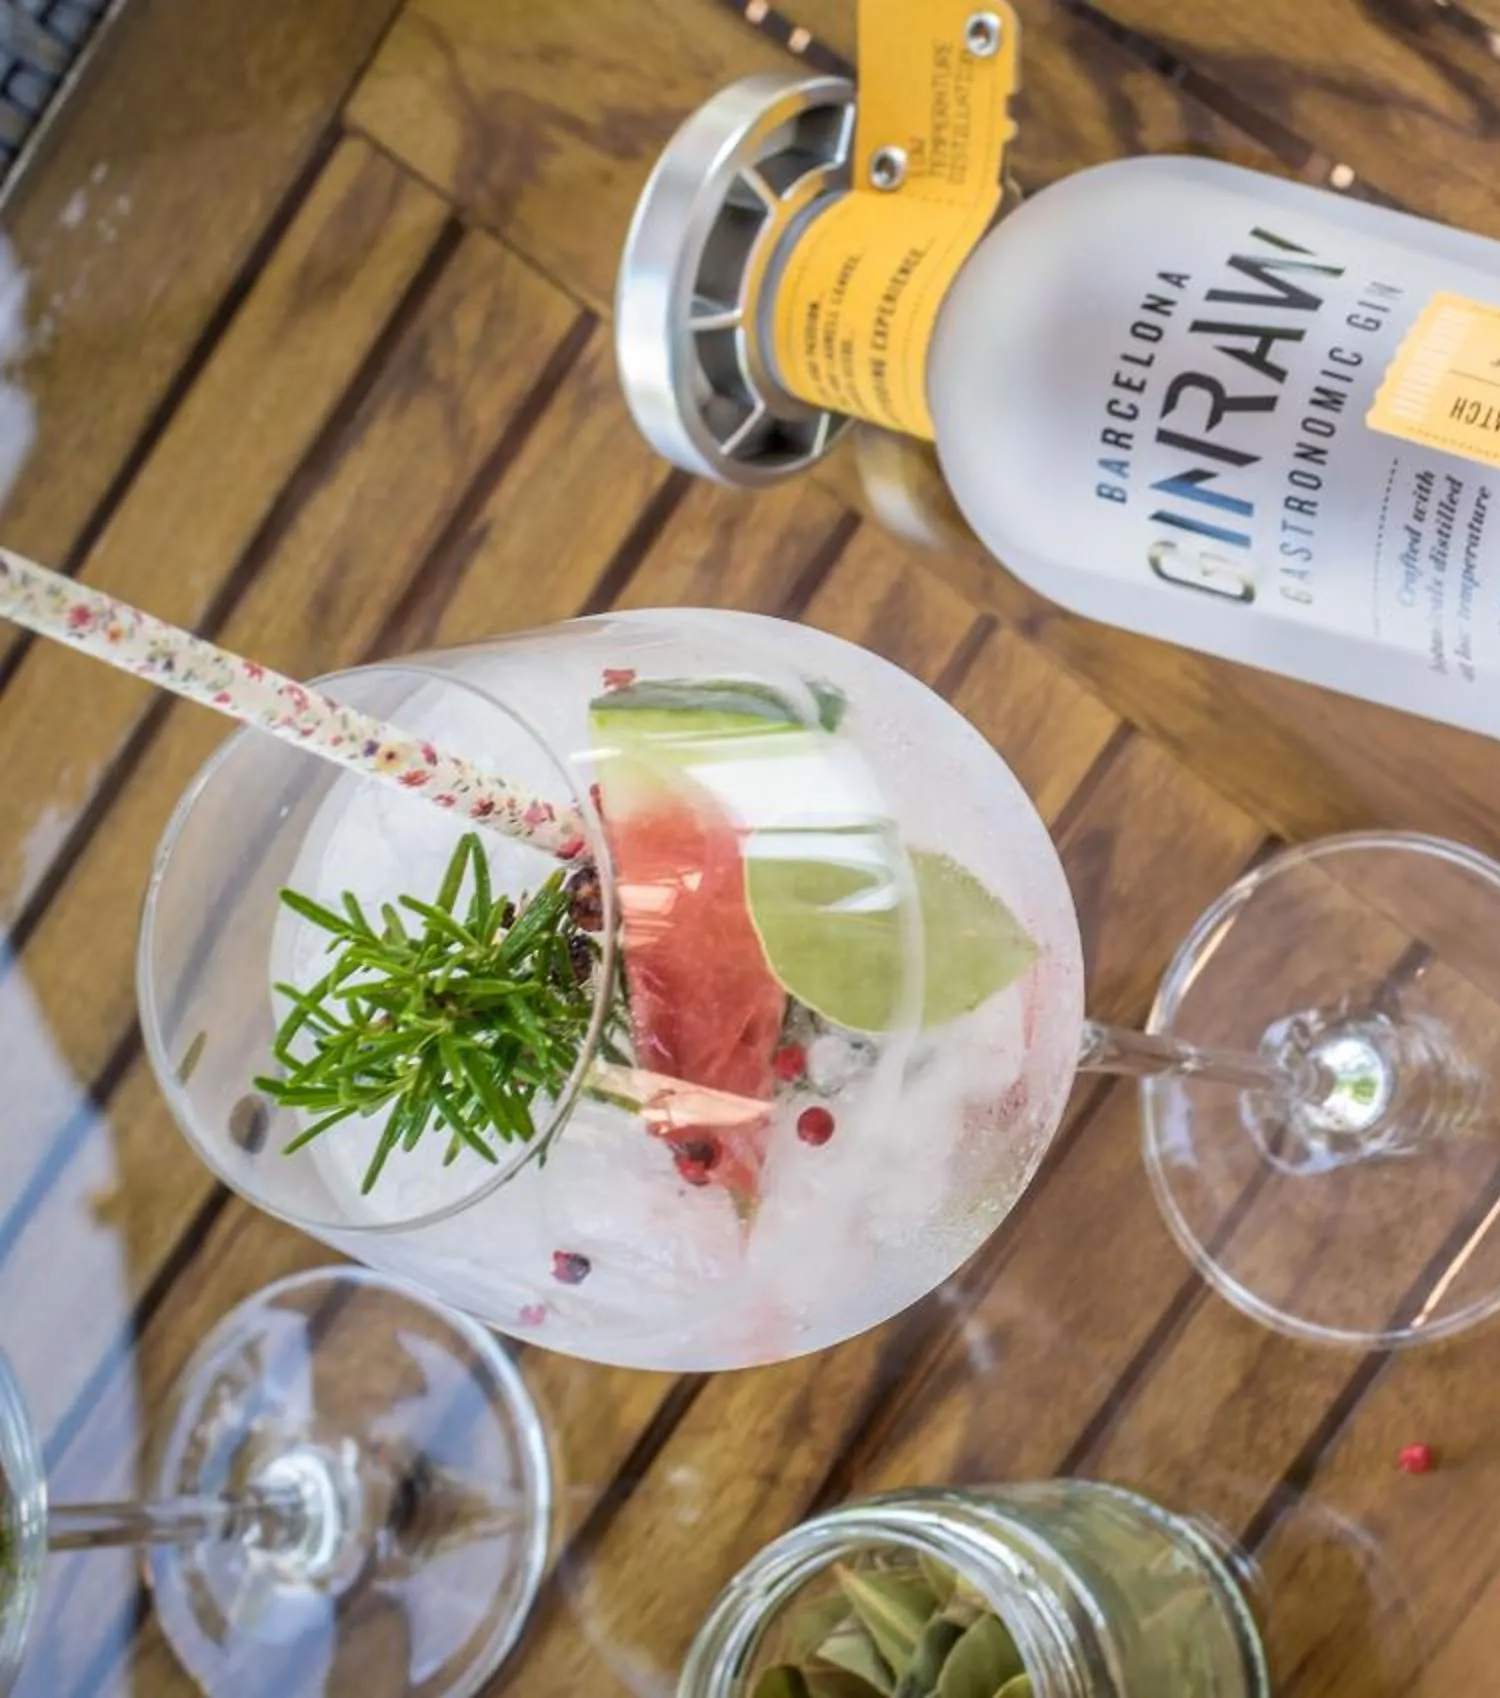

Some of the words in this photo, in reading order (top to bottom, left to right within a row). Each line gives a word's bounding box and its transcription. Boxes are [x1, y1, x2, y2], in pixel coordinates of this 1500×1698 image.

[1095, 268, 1191, 504] BARCELONA
[1147, 226, 1346, 605] GINRAW
[1280, 346, 1363, 605] GASTRONOMIC
[1346, 280, 1404, 333] GIN
[1410, 471, 1435, 522] with
[1429, 474, 1463, 571] distilled
